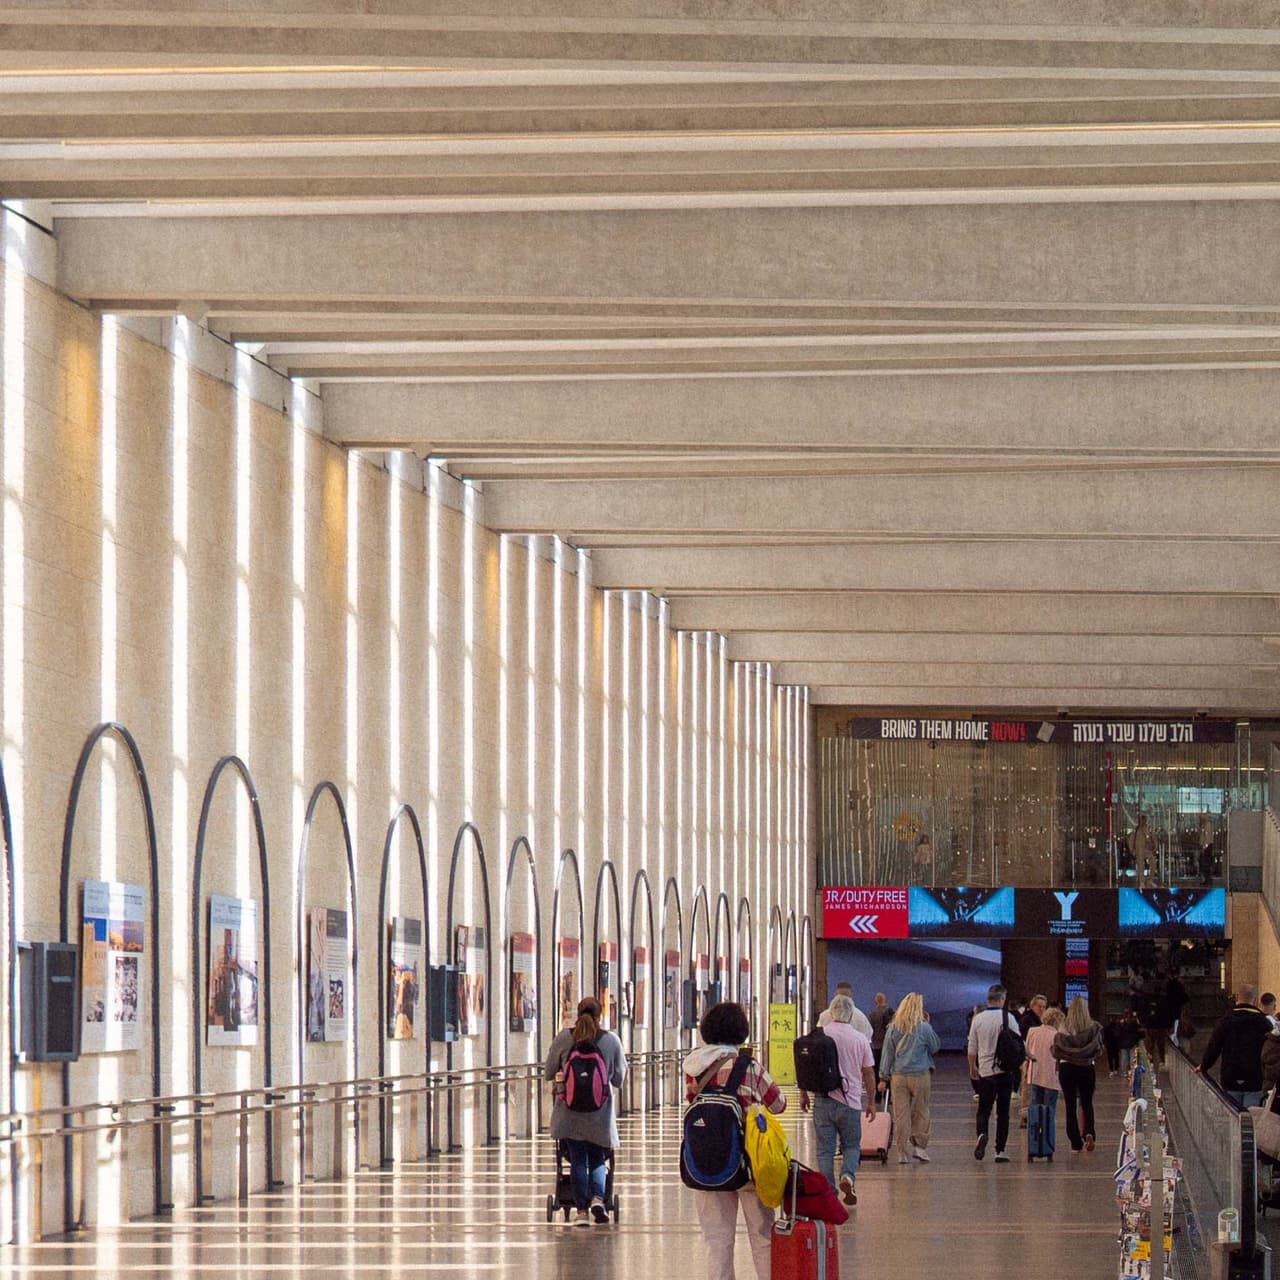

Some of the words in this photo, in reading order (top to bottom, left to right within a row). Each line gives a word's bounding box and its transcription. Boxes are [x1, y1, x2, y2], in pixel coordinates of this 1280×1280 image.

[881, 719, 917, 738] BRING
[920, 720, 952, 739] THEM
[955, 721, 989, 740] HOME
[991, 722, 1025, 741] NOW!
[1073, 722, 1104, 743] בעזה
[1106, 722, 1135, 743] שבוי
[1138, 722, 1167, 743] שלנו
[1169, 722, 1194, 743] הלב
[1054, 891, 1080, 920] Y
